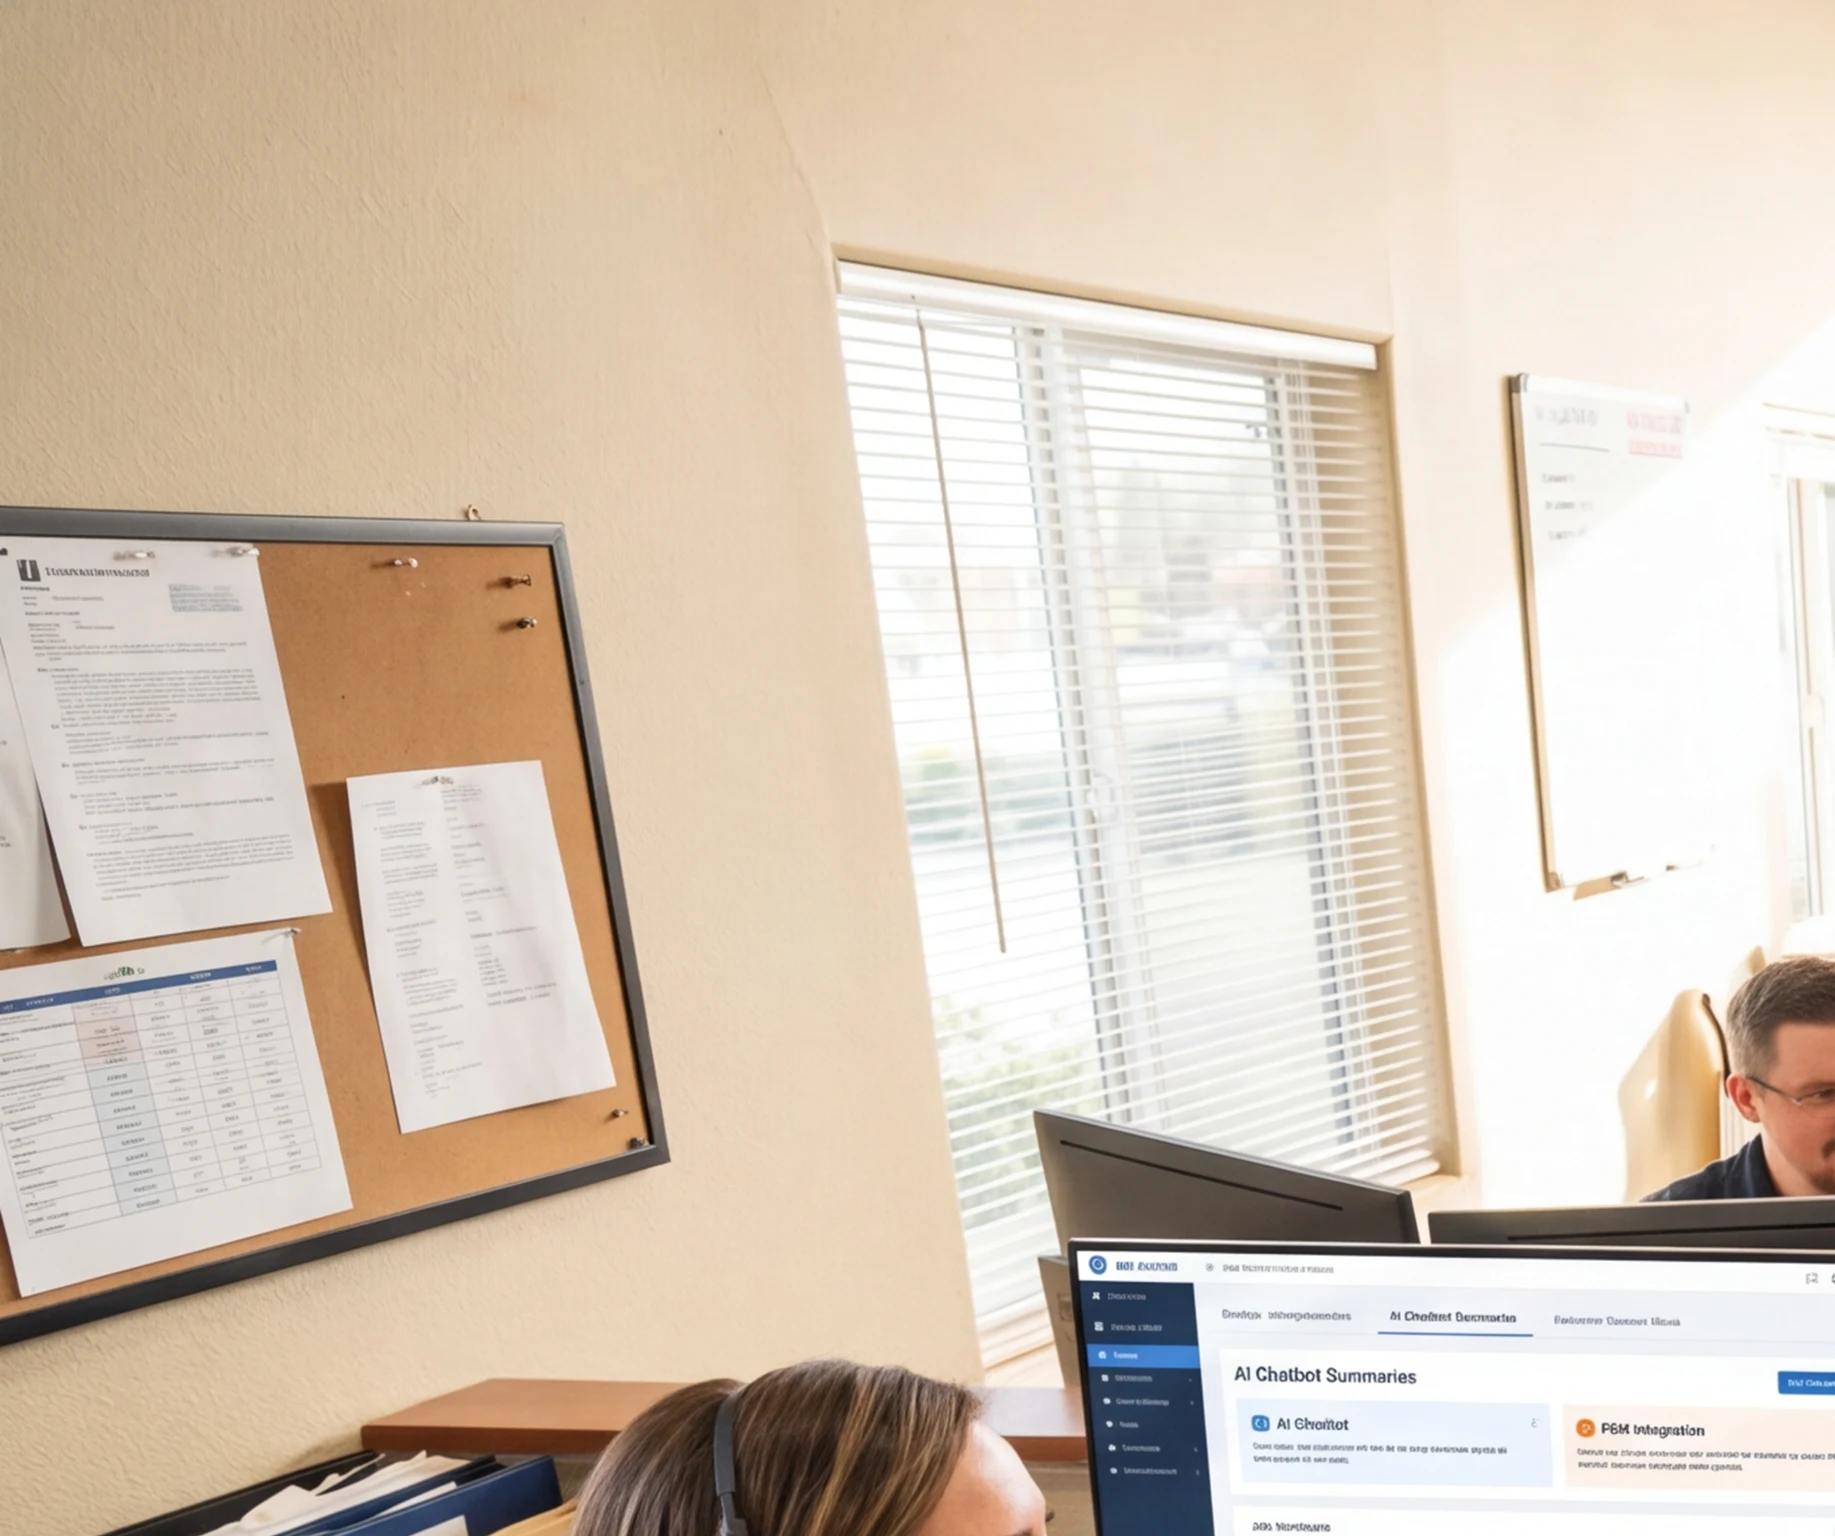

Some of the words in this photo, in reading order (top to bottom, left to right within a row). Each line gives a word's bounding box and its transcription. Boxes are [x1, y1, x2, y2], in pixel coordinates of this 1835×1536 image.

[1234, 1365, 1251, 1382] AI
[1255, 1366, 1322, 1384] Chatbot
[1326, 1367, 1418, 1385] Summaries
